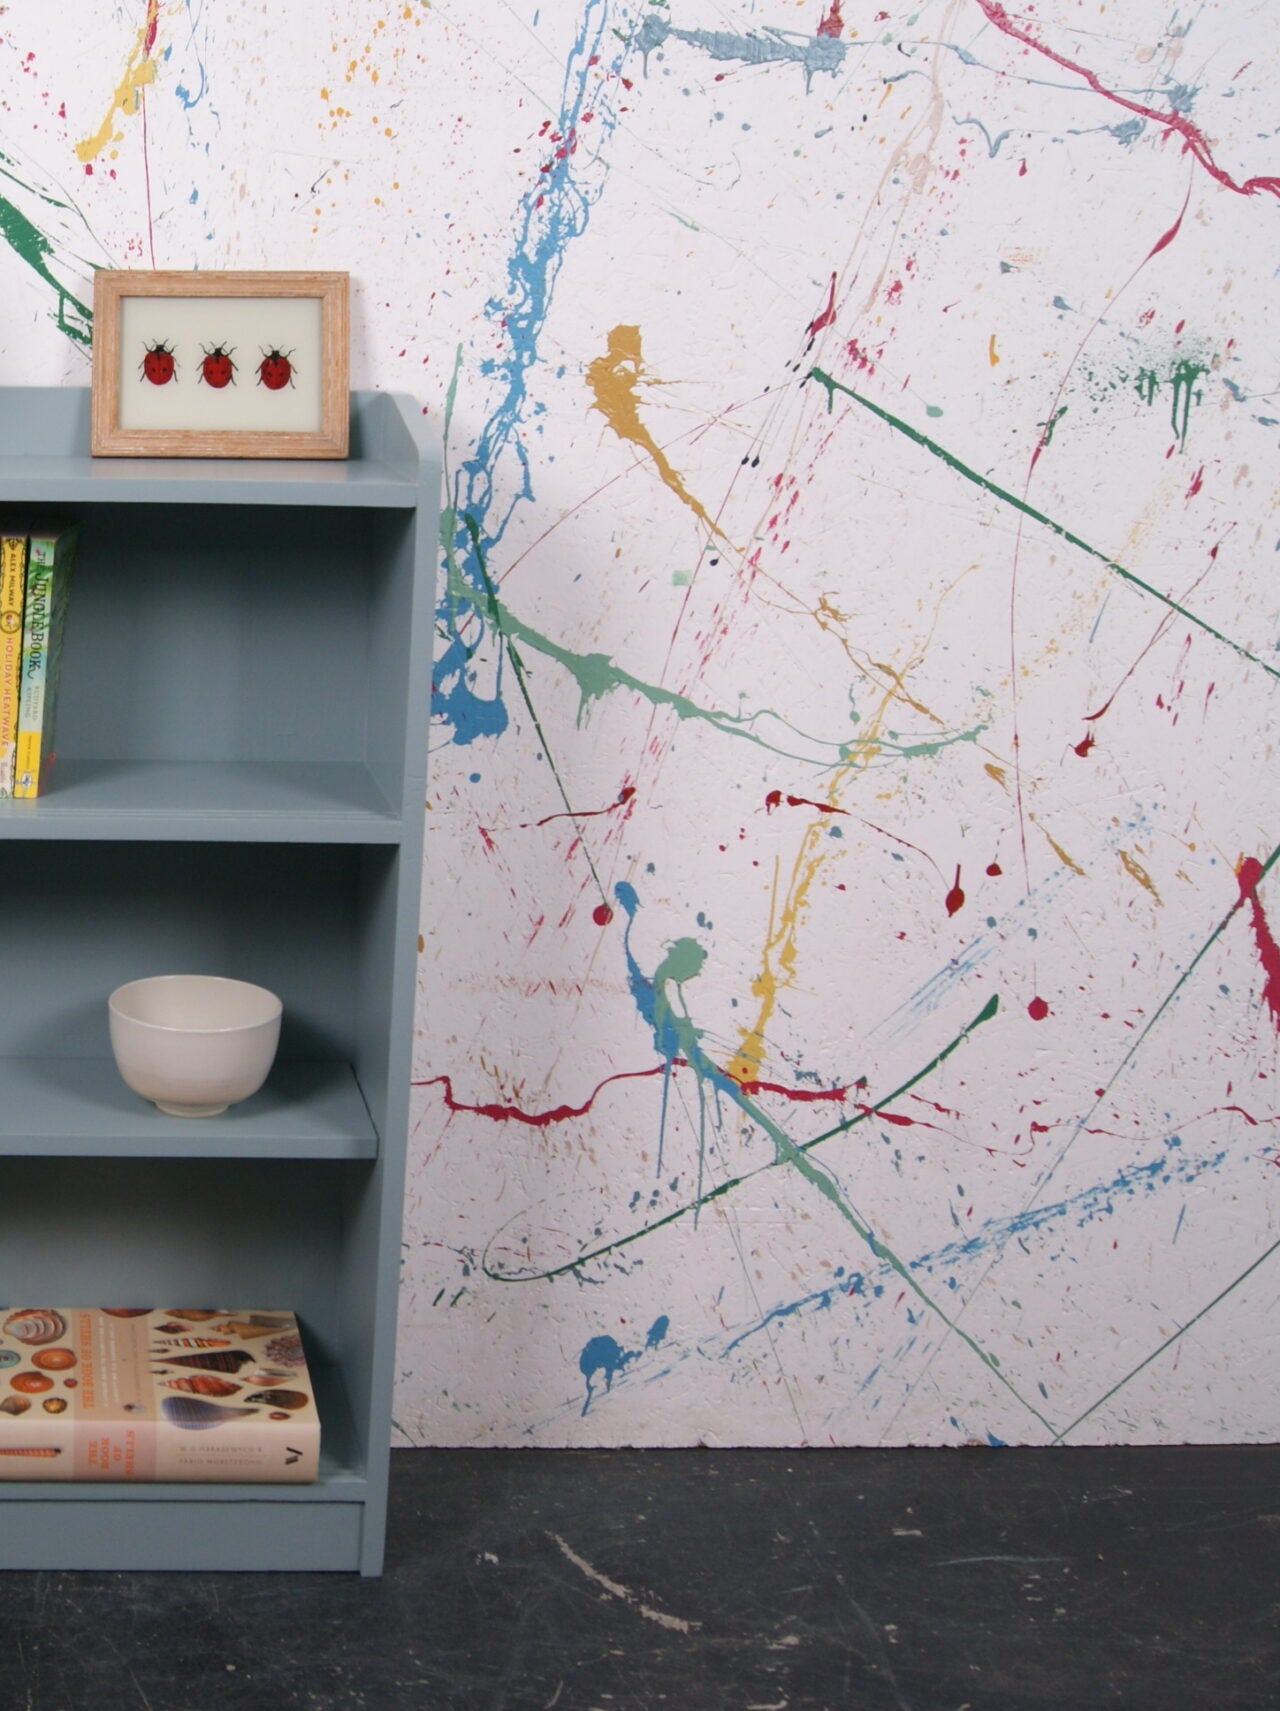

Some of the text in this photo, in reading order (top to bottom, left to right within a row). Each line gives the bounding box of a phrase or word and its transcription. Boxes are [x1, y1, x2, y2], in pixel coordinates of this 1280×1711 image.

[8, 575, 16, 606] MILWAY
[27, 551, 49, 679] THE JUNGLE BOOK
[1, 637, 14, 747] HOLIDAY HEATWAVE
[79, 1314, 95, 1409] THE BOOK OF SHELLS
[88, 1440, 98, 1465] THE
[100, 1437, 110, 1469] BOOK
[113, 1445, 122, 1462] OF
[125, 1430, 136, 1476] SHELLS
